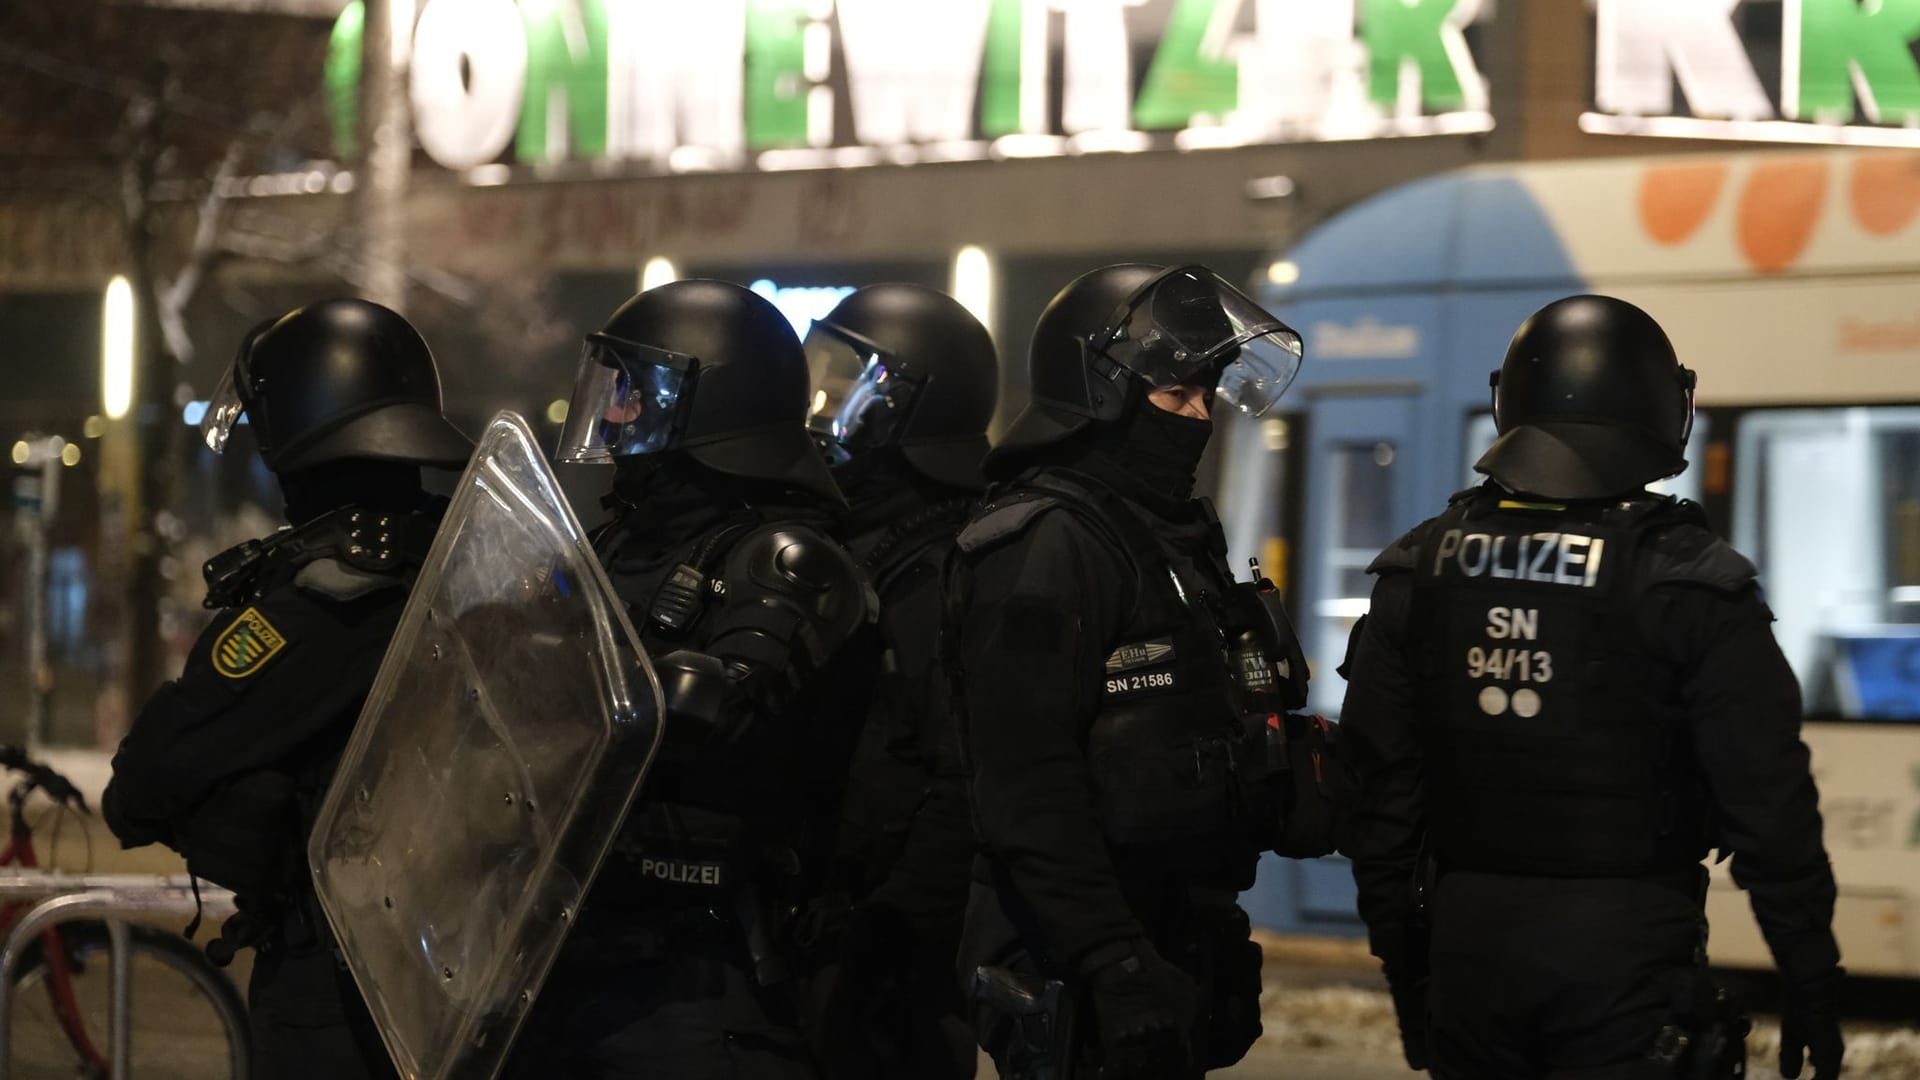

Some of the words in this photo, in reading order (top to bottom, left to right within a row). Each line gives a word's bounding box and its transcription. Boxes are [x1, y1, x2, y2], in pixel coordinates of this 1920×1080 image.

[1433, 529, 1604, 587] POLIZEI
[1486, 606, 1539, 640] SN
[1467, 647, 1553, 682] 94/13
[1106, 678, 1128, 693] SN
[1131, 672, 1173, 689] 21586
[642, 859, 720, 885] POLIZEI
